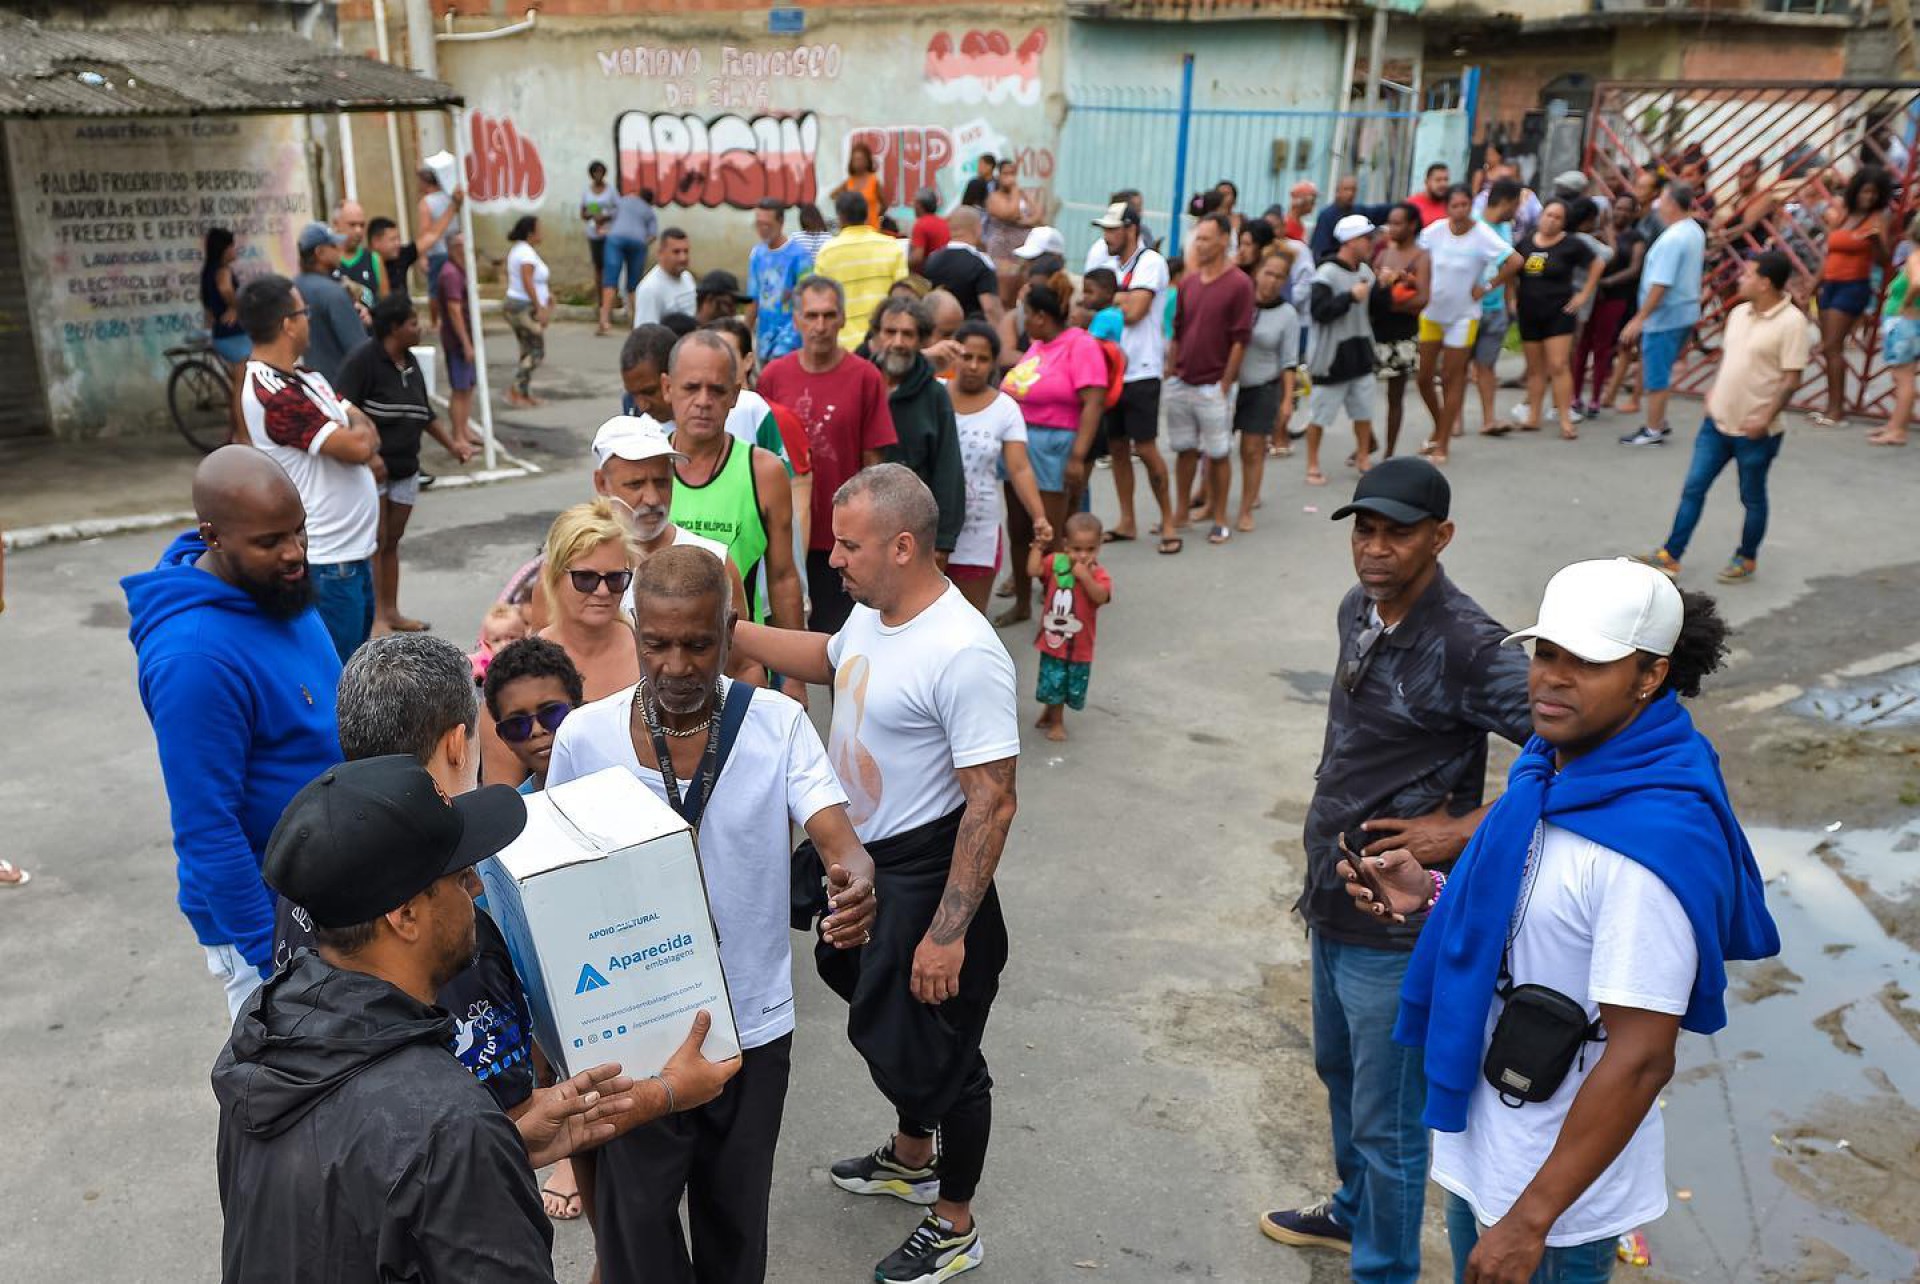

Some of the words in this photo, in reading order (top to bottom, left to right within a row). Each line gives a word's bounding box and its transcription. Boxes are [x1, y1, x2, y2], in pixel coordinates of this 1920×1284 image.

[706, 721, 721, 754] Hurley
[588, 925, 615, 940] APOIO
[608, 932, 693, 971] Aparecida
[644, 948, 694, 971] embalagens
